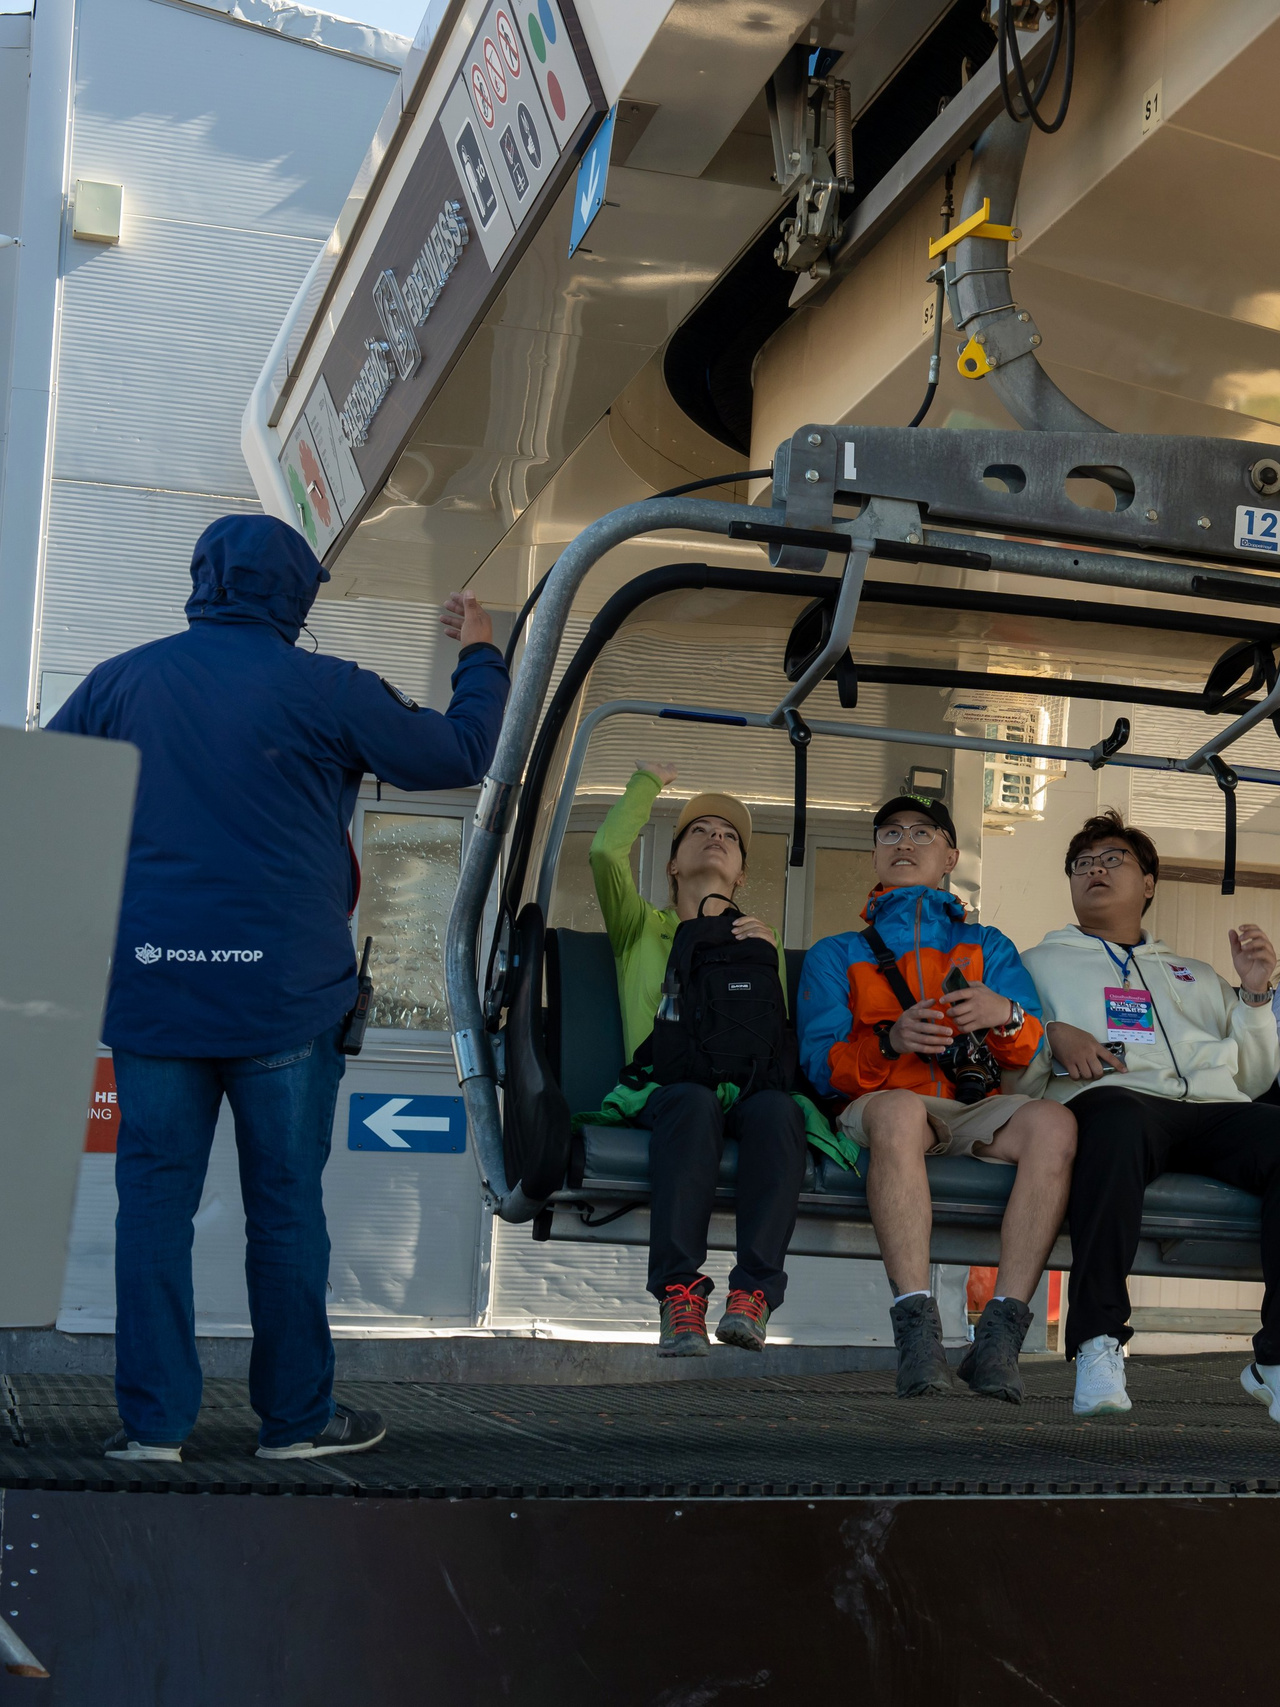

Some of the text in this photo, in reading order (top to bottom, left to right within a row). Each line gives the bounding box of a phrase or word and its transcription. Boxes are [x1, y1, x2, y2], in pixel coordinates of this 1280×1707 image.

[1145, 93, 1158, 120] S1
[401, 200, 469, 327] EDELWEISS
[924, 303, 934, 324] S2
[339, 337, 394, 447] ЭДЕЛЬВЕЙС
[1244, 510, 1278, 538] 12
[166, 949, 264, 962] РОЗА ХУТОР
